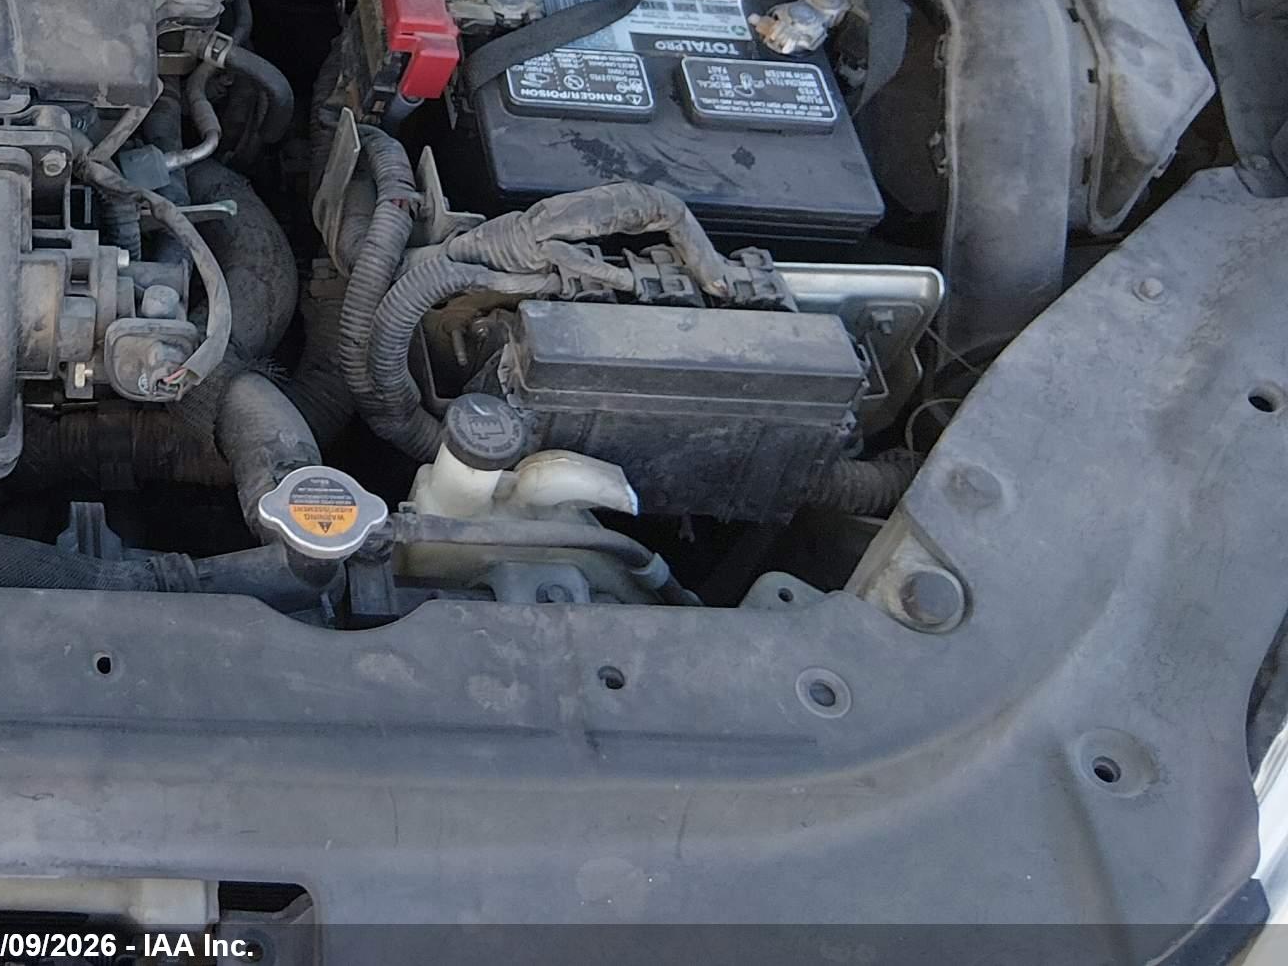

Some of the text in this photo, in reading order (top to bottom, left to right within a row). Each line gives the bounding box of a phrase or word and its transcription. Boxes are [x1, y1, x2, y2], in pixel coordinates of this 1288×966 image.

[654, 39, 740, 55] TOTALPRO
[707, 65, 728, 75] FAST
[764, 69, 815, 80] WITH WATER
[709, 73, 731, 82] HELP
[696, 79, 732, 89] MEDICAL
[765, 78, 818, 88] IMMEDIATELY
[520, 88, 623, 102] DANGER/POISON
[719, 88, 735, 98] GET
[798, 87, 821, 96] EYES
[795, 94, 824, 105] FLUSH
